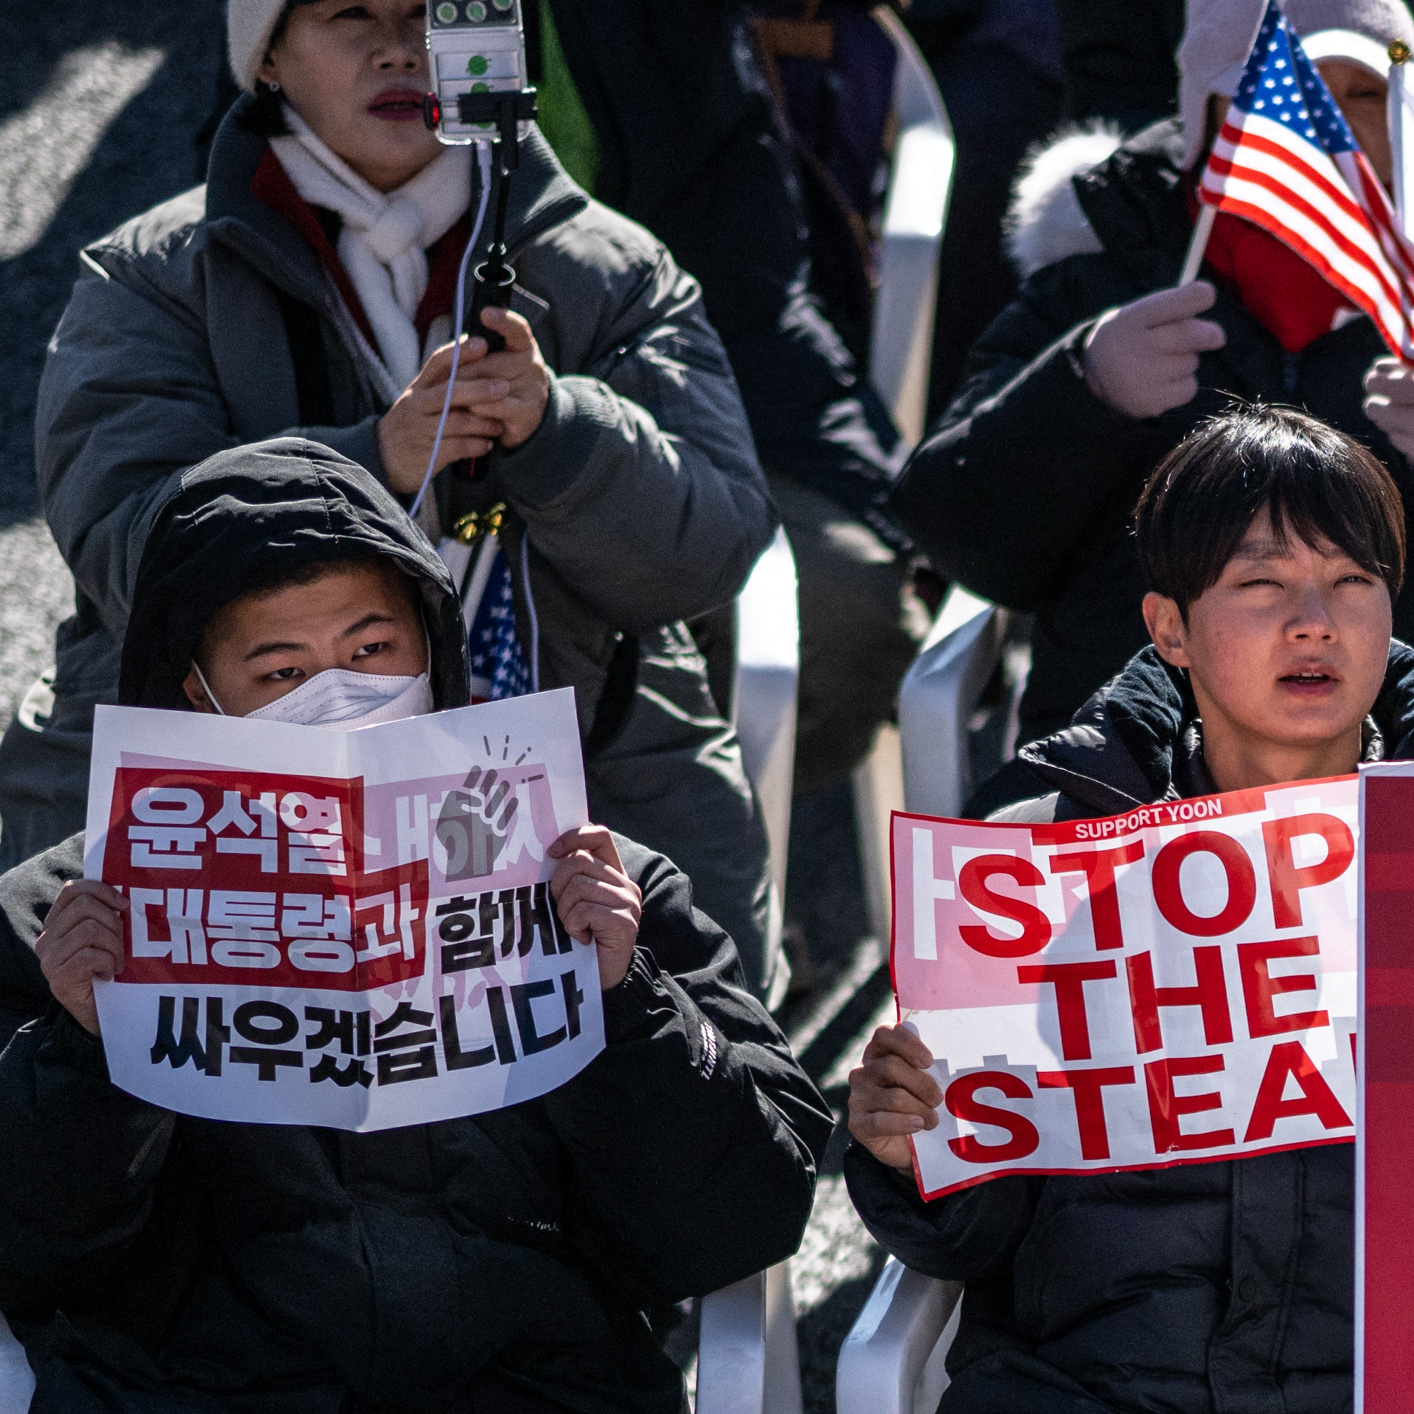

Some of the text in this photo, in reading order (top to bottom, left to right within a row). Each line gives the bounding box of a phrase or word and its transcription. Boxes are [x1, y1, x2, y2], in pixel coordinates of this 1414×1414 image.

[127, 788, 347, 876] 윤석열
[1075, 799, 1223, 840] SUPPORT YOON
[128, 880, 575, 974] 대통령과 함께
[957, 812, 1356, 958] STOP
[150, 970, 584, 1090] 싸우겠습니다
[1017, 935, 1331, 1061] THE
[943, 1032, 1356, 1164] STEA
